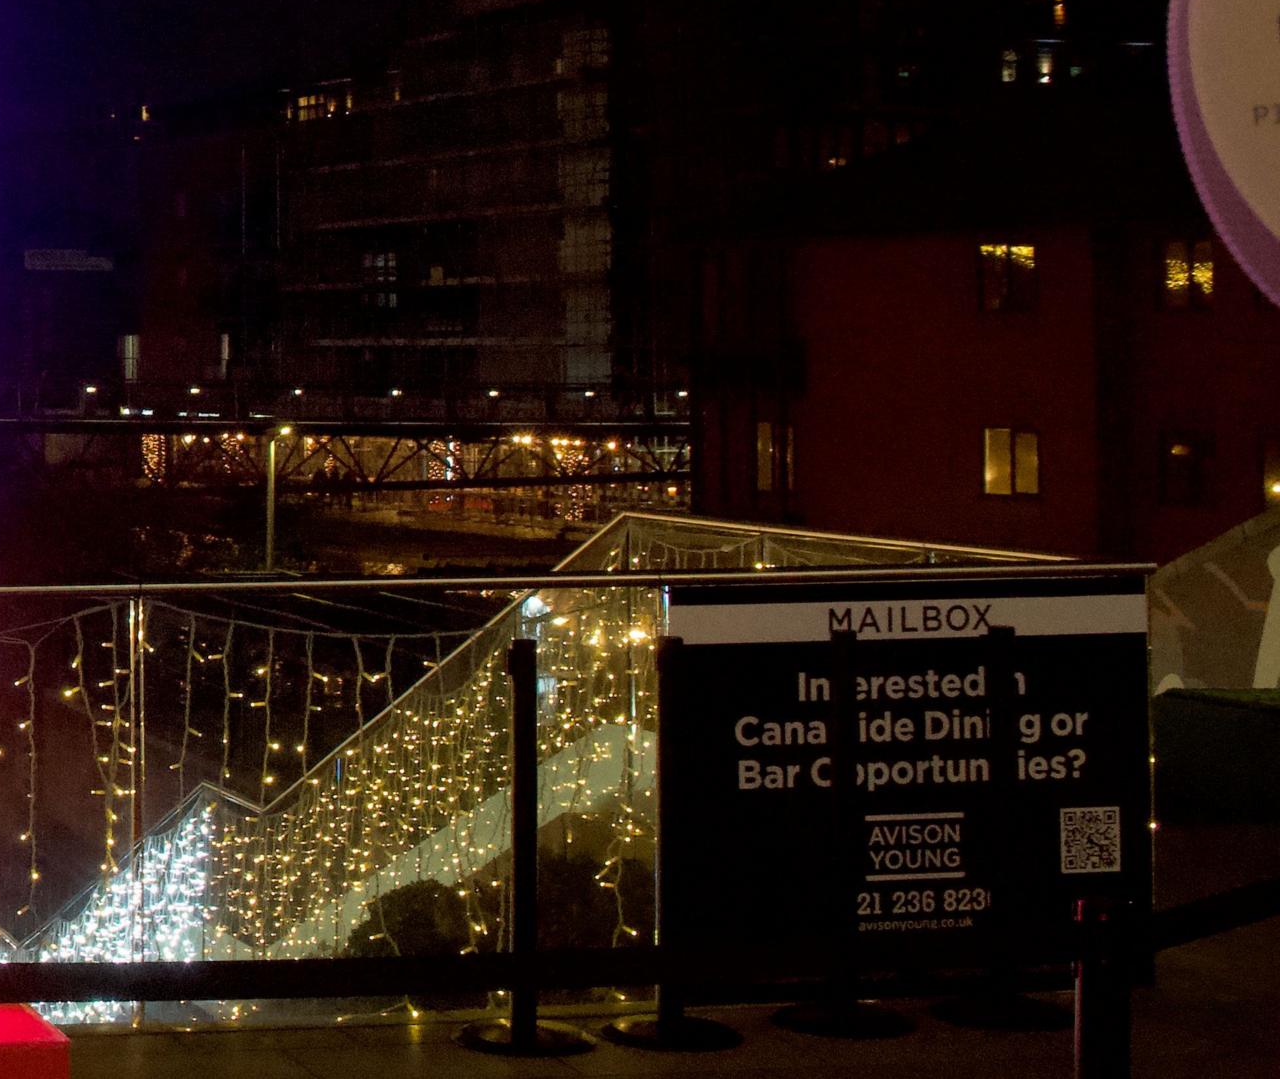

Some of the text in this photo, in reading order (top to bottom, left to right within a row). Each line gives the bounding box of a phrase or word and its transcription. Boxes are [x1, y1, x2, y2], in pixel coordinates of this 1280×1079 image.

[828, 604, 992, 634] MAILBOX
[797, 665, 987, 702] Inerested
[1050, 711, 1089, 737] or
[738, 759, 801, 790] Bar
[868, 823, 961, 846] AVISON
[869, 847, 961, 871] YOUNG
[891, 890, 936, 914] 236
[942, 888, 992, 912] 823
